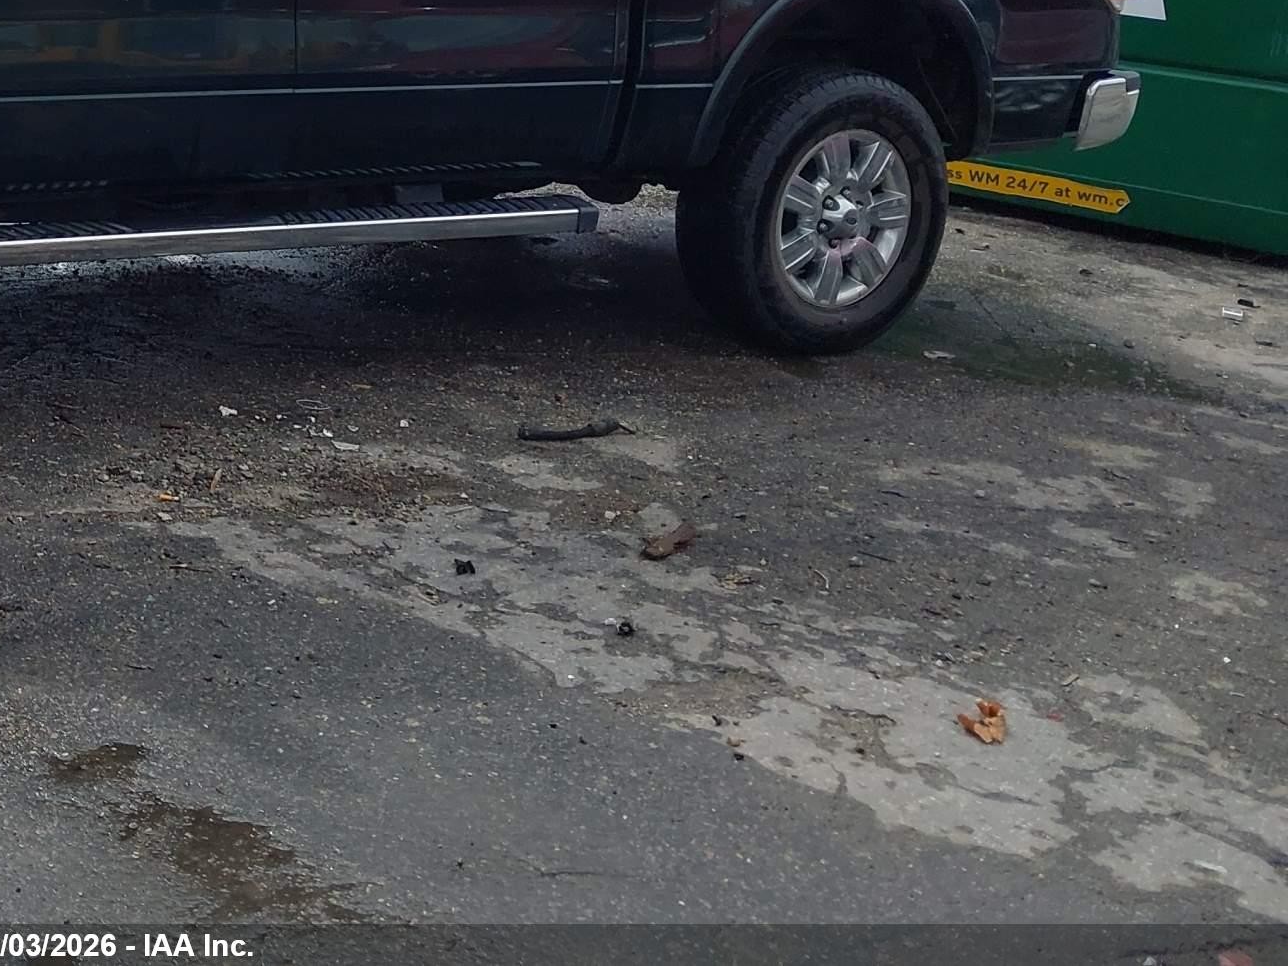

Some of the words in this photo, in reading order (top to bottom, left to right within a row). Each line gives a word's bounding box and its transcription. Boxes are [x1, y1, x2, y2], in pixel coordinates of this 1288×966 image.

[969, 169, 1000, 187] WM
[1005, 176, 1050, 194] 24/7
[1055, 185, 1072, 198] at
